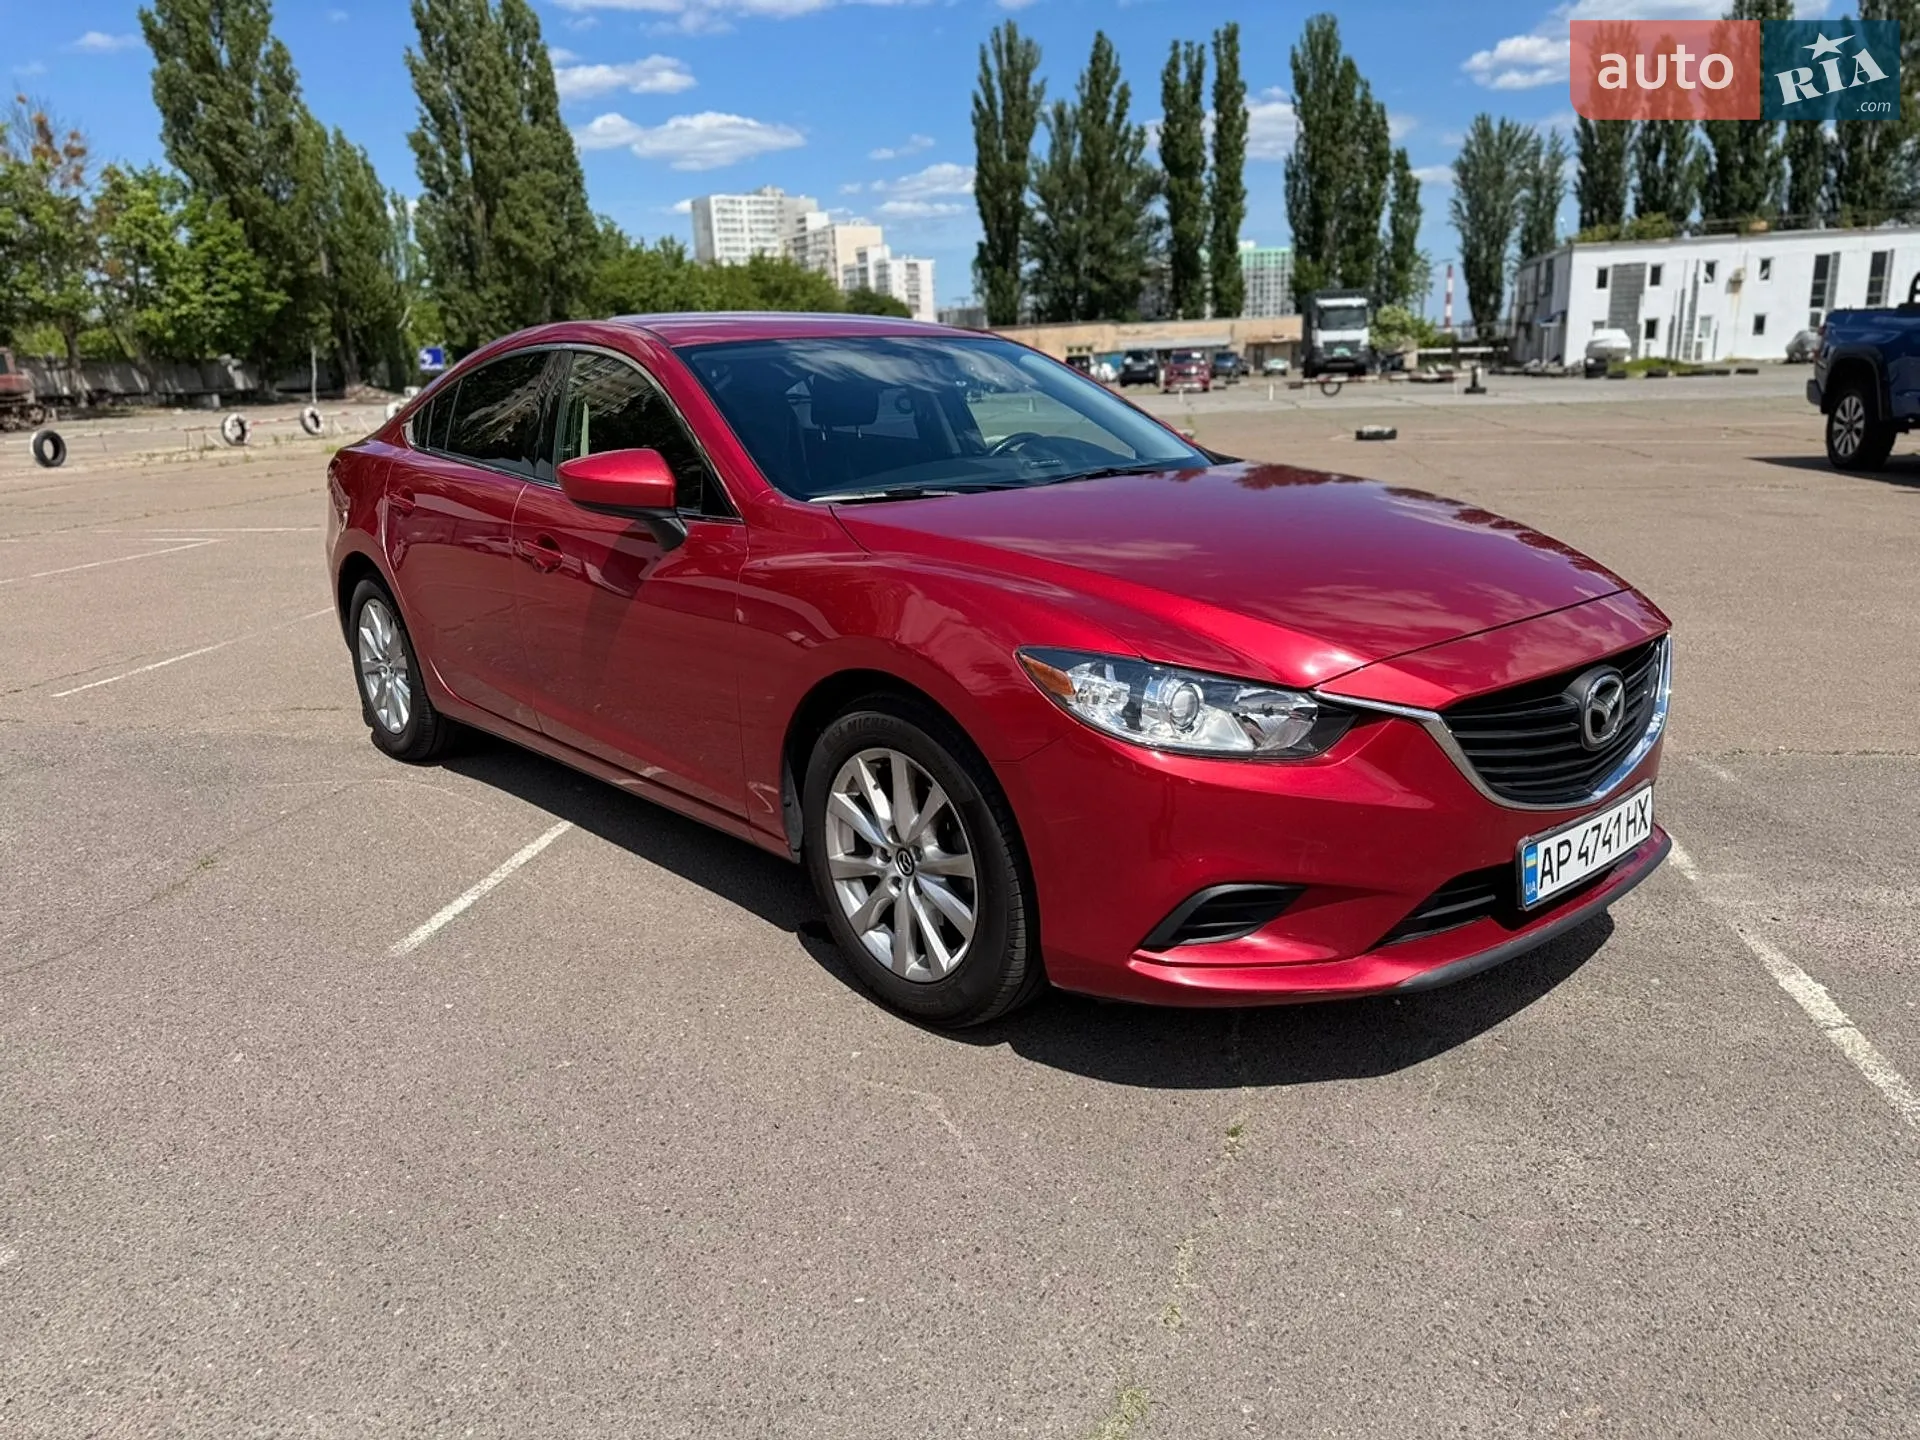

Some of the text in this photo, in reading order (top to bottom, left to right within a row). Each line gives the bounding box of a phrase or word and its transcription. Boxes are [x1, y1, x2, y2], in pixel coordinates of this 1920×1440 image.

[1539, 794, 1649, 890] AP 4741 HX
